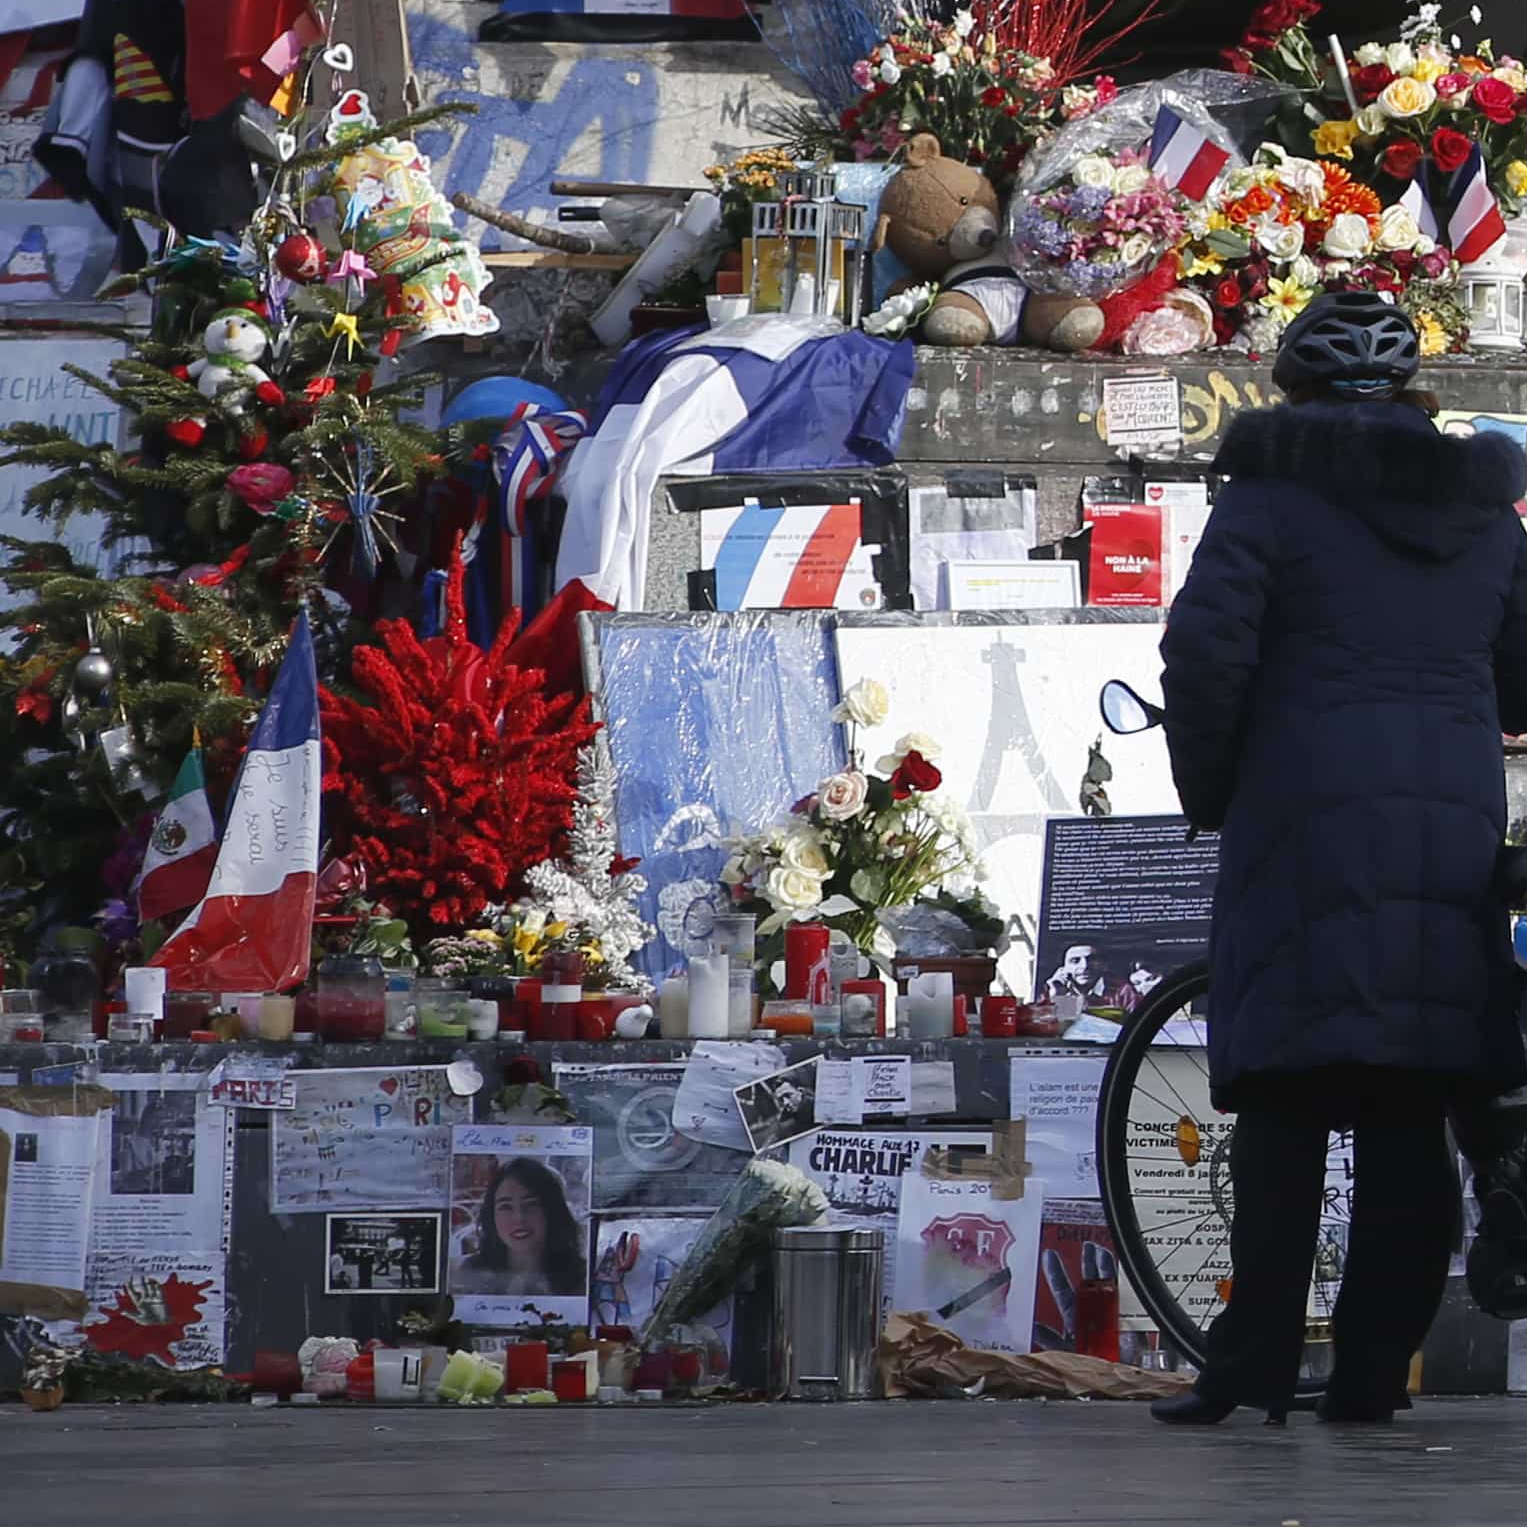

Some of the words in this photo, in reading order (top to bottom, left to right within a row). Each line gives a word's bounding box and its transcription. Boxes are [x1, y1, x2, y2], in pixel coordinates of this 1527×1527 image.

[1105, 556, 1127, 565] NON
[1136, 556, 1149, 565] LA
[1029, 1082, 1062, 1092] L'islam
[1063, 1084, 1080, 1092] est
[1080, 1083, 1099, 1092] une
[1028, 1094, 1064, 1105] religion
[1065, 1094, 1078, 1104] de
[1028, 1105, 1070, 1116] d'accord
[1071, 1105, 1090, 1116] ???
[1133, 1122, 1177, 1133] CONCE
[815, 1133, 875, 1150] HOMMAGE
[1126, 1138, 1178, 1149] VICTIME
[1134, 1168, 1186, 1179] Vendredi
[1166, 1237, 1192, 1246] ZITA
